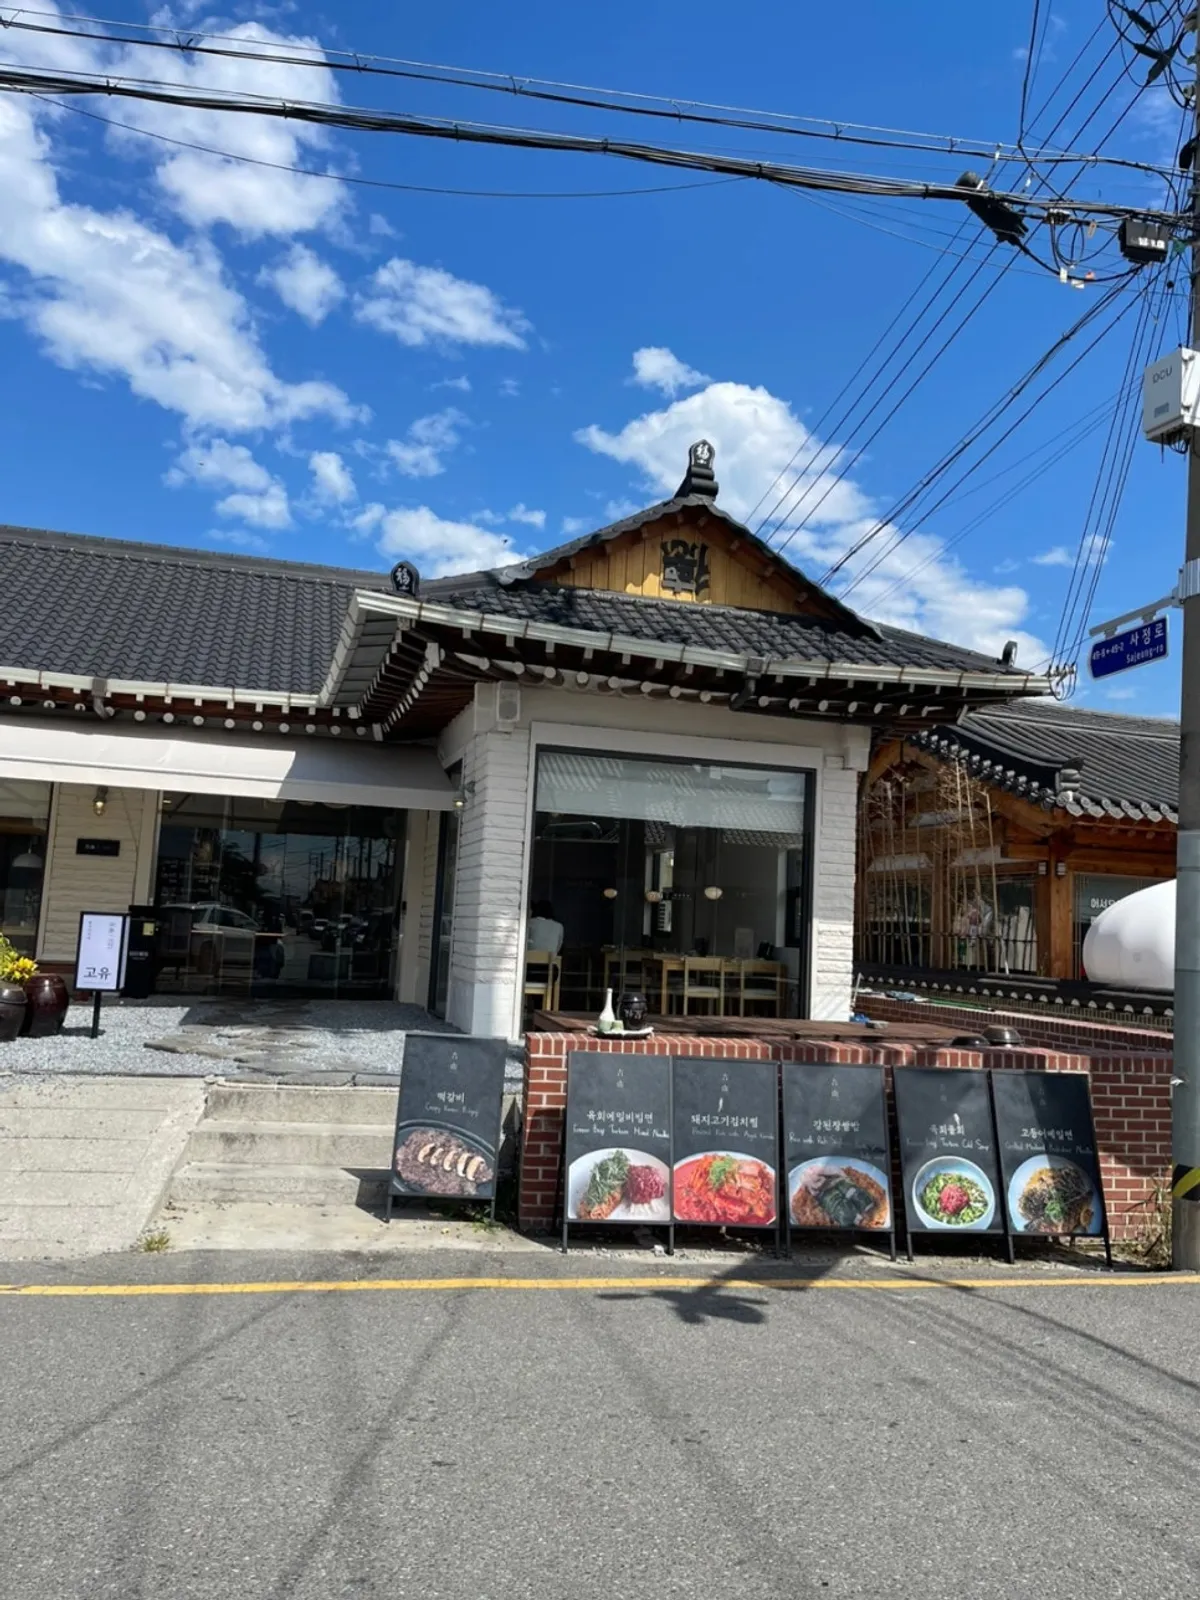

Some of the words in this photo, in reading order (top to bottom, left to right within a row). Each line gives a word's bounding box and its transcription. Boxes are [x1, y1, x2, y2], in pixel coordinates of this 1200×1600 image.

[1129, 622, 1164, 646] 사정로
[83, 966, 112, 981] 고유
[436, 1091, 465, 1103] 떡갈비
[690, 1113, 759, 1129] 돼지고기김치찜
